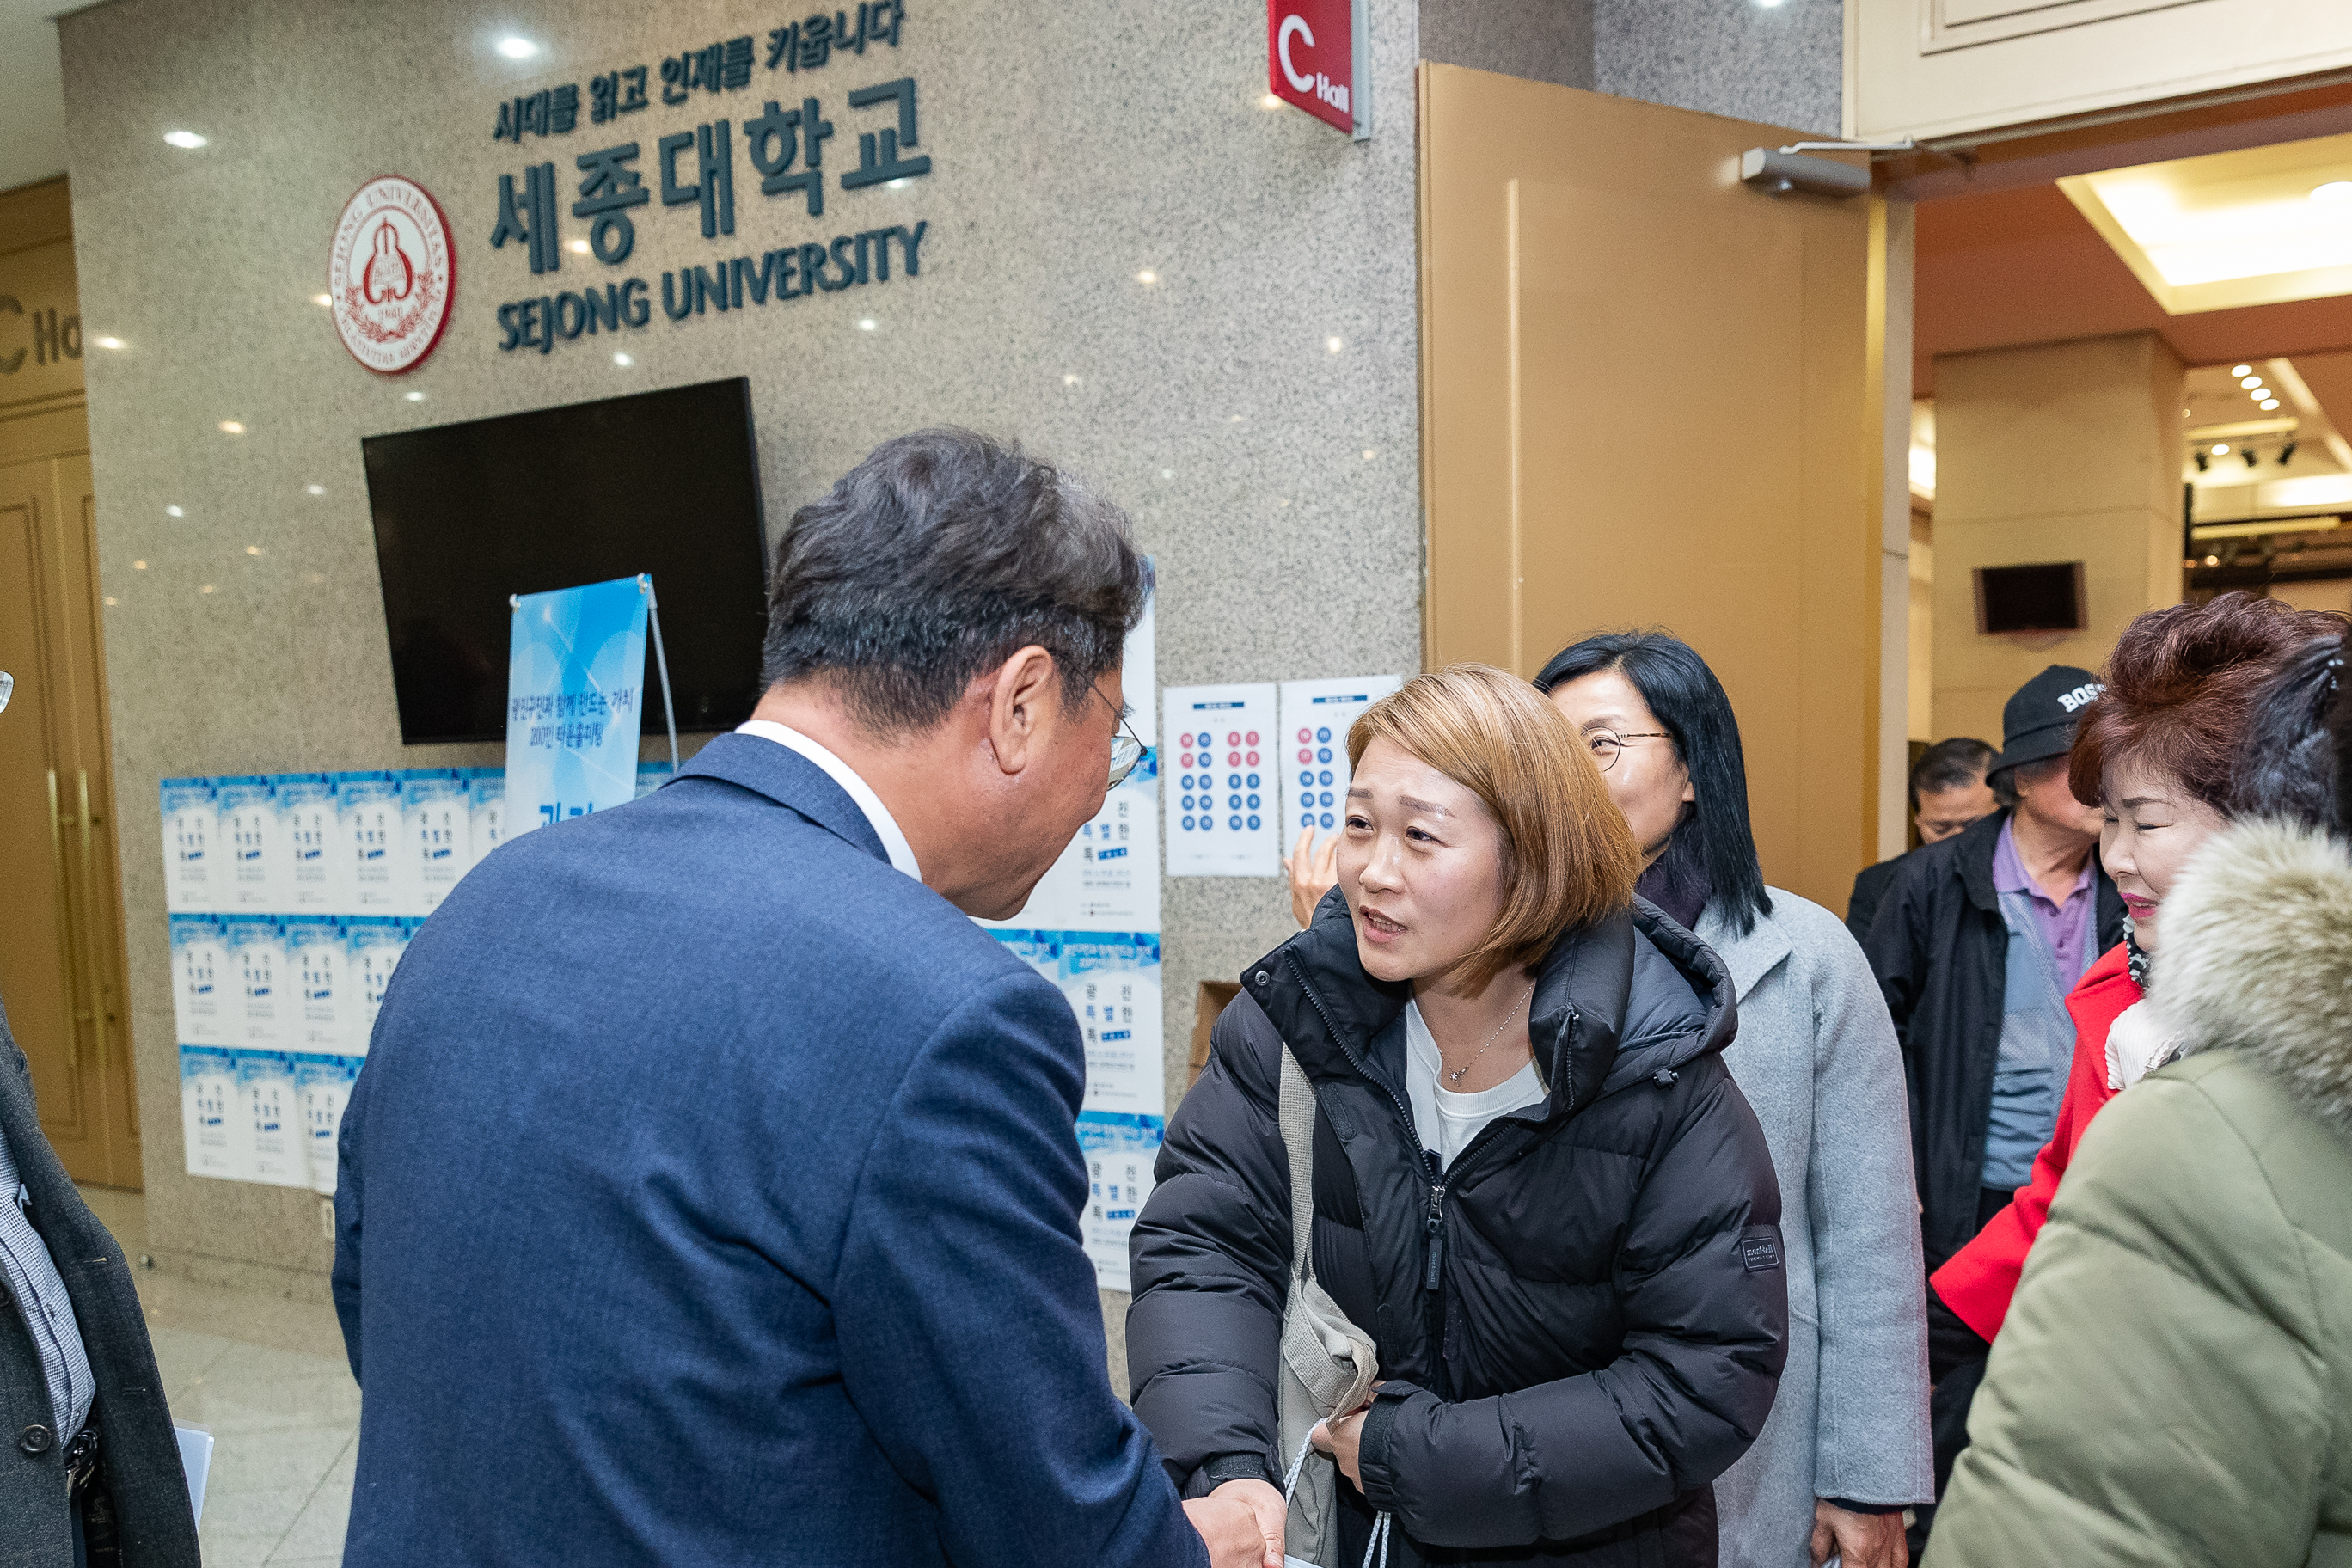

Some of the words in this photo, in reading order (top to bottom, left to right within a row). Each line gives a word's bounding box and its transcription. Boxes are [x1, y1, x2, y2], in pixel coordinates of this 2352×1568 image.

[493, 83, 579, 144] 시대를
[590, 65, 649, 124] 읽고
[660, 35, 755, 107] 인재를
[766, 0, 906, 72] 키웁니다
[1278, 14, 1316, 94] C
[1316, 71, 1350, 113] Hall
[490, 77, 931, 274] 세종대학교
[497, 278, 651, 354] SEJONG
[661, 220, 928, 322] UNIVERSITY
[611, 688, 634, 714] 가치
